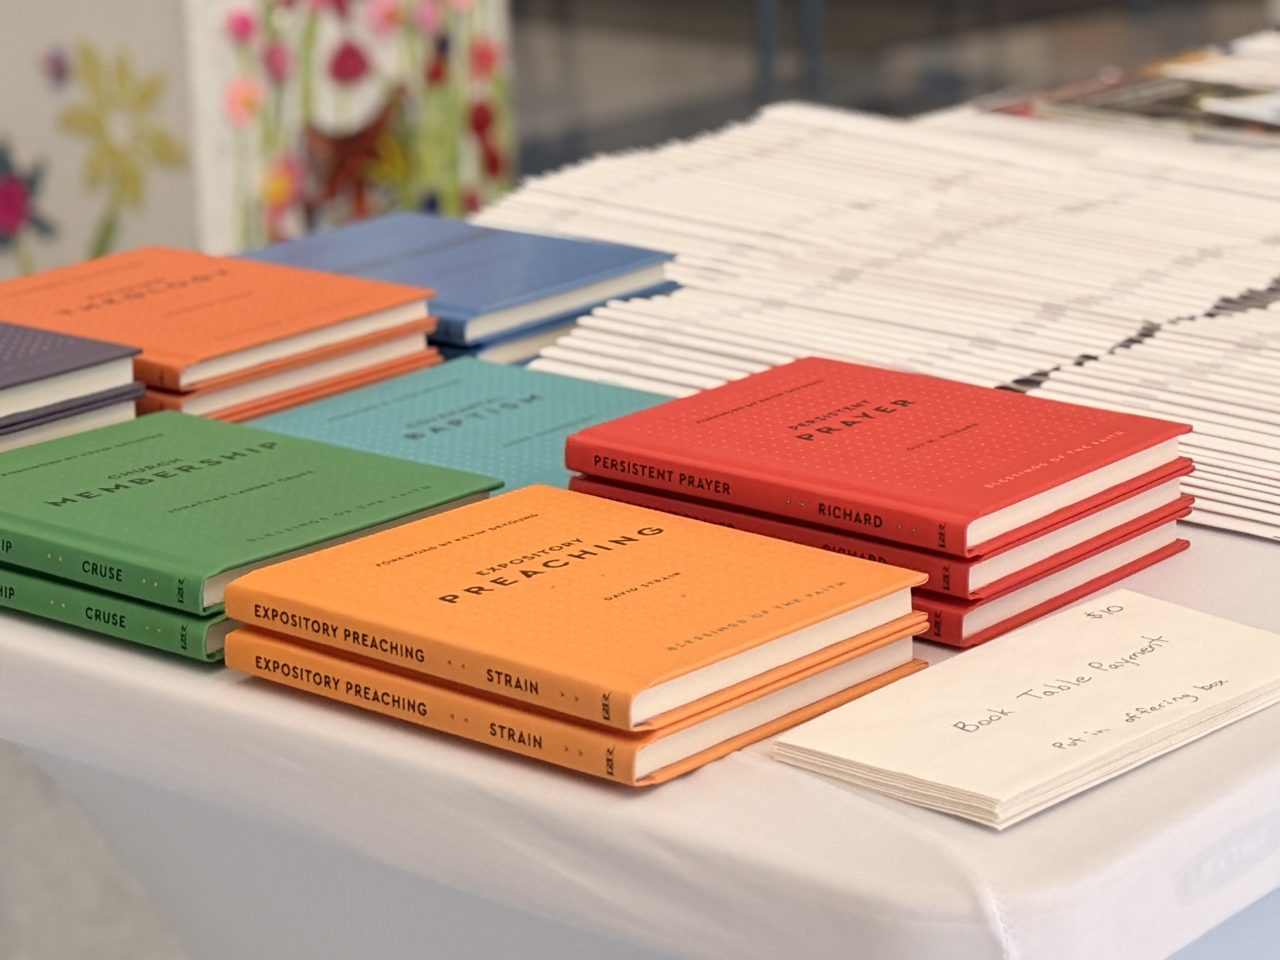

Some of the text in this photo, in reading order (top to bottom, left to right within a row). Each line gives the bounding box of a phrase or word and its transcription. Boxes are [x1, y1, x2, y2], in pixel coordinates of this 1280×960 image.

[788, 400, 871, 431] PERSISTENT
[795, 399, 916, 441] PRAYER
[45, 442, 278, 507] MEMBERSHIP
[107, 458, 184, 480] CHURCH
[594, 455, 883, 528] PERSISTENT PRAYER RICHARD
[82, 560, 123, 582] CRUSE
[438, 527, 664, 604] PREACHING
[475, 538, 584, 576] EXPOSITORY
[604, 572, 681, 601] DAVID STRAIN
[1084, 604, 1124, 621] $10
[85, 607, 126, 628] CRUSE
[667, 581, 847, 652] BLESSINGS OF THE FAITH
[254, 604, 540, 696] EXPOSITORY PREACHING STRAIN
[255, 656, 543, 750] EXPOSITORY PREACHING STRAIN
[953, 635, 1171, 733] Book Table Payment
[1052, 730, 1085, 751] Put
[1124, 691, 1199, 724] offering
[1193, 678, 1229, 692] box
